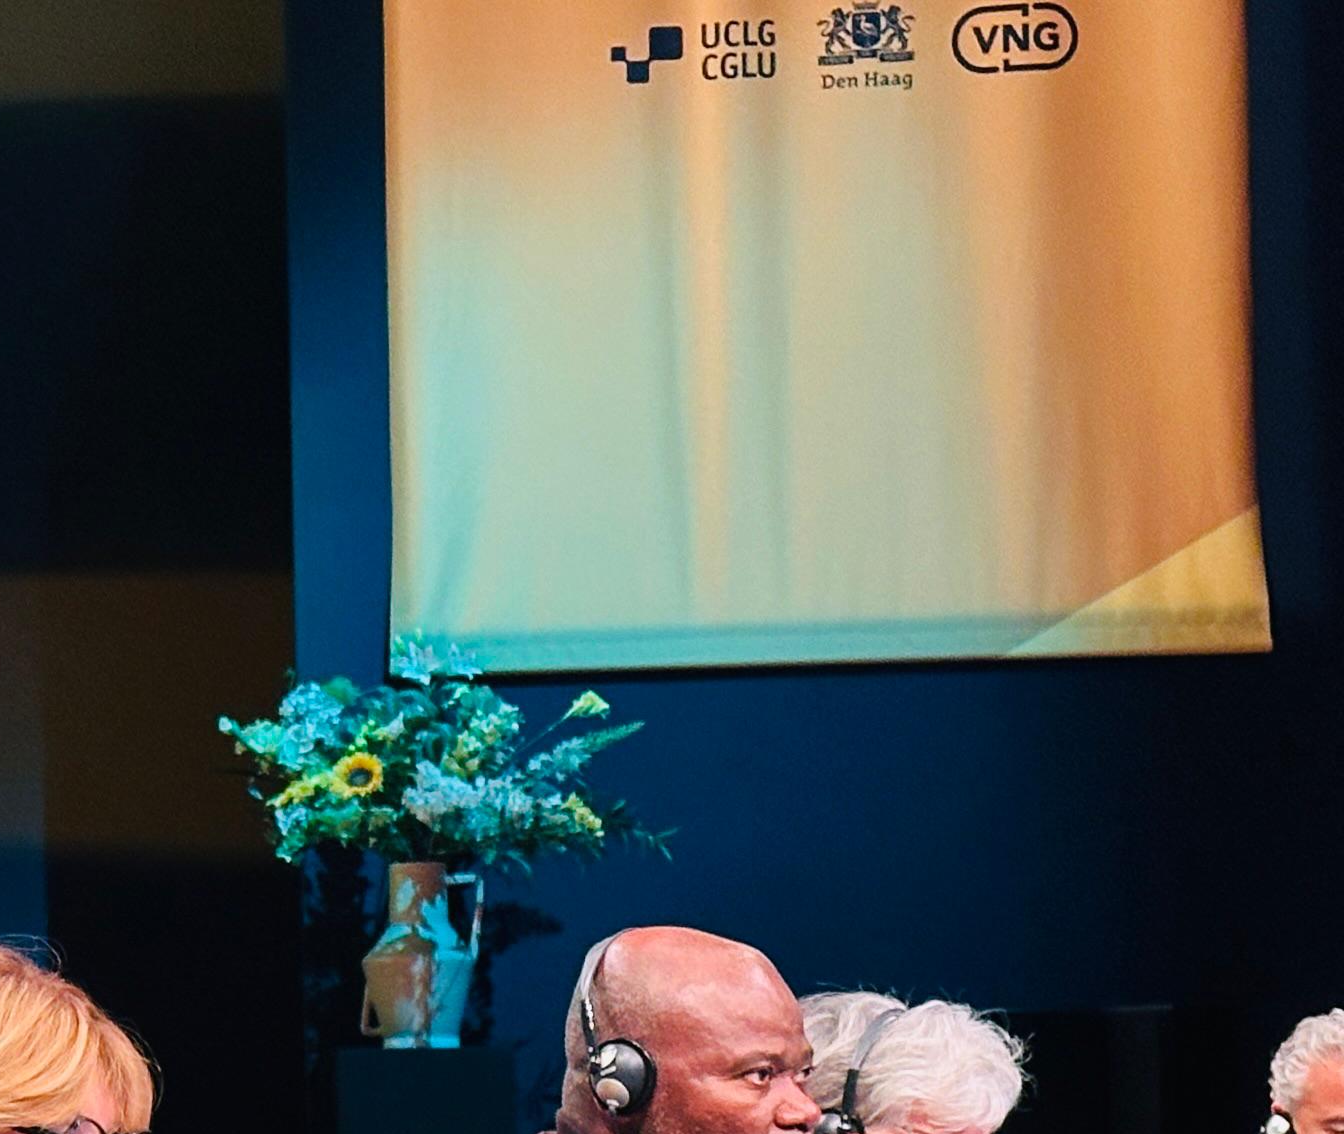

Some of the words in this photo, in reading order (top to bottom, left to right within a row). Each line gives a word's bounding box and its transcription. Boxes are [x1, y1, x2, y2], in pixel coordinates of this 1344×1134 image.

[702, 19, 775, 48] UCLG
[973, 21, 1060, 53] VNG
[702, 52, 776, 80] CGLU
[822, 75, 858, 89] Den
[864, 72, 912, 90] Haag
